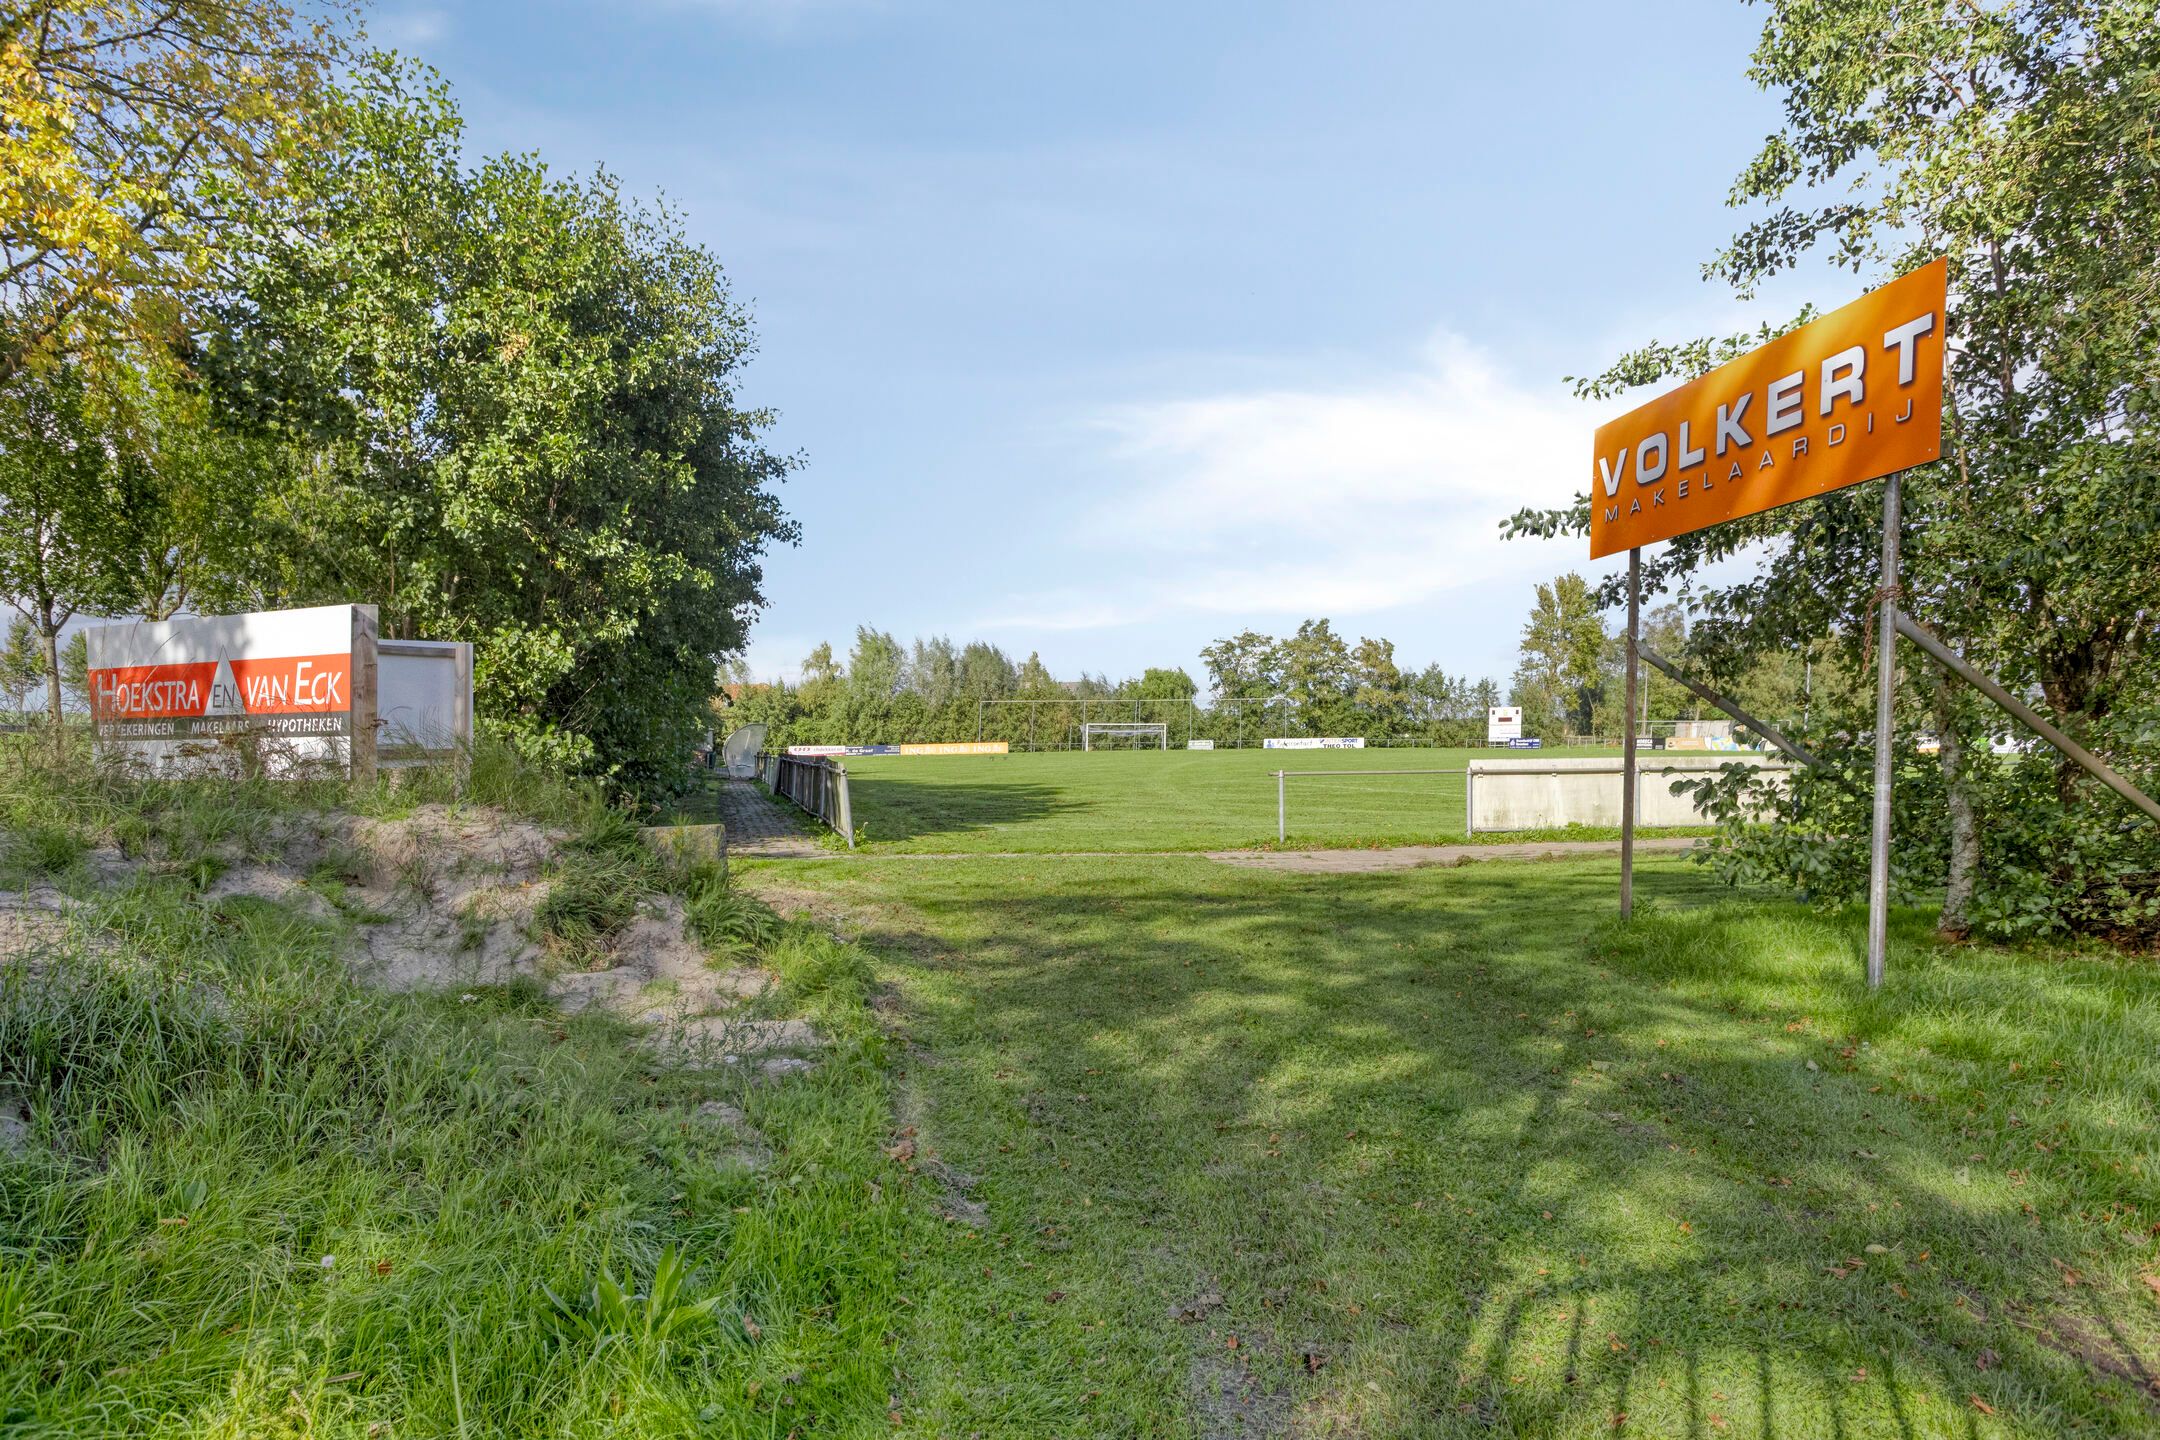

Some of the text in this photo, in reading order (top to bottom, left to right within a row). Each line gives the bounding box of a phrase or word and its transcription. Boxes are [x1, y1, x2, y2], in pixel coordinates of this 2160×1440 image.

[1598, 312, 1934, 497] VOLKERT
[1604, 398, 1912, 523] MAKELAARDIJ
[97, 661, 343, 713] HOEKSTRA EN VAN ECK
[267, 717, 342, 734] HYPOTHEKEN
[905, 747, 923, 755] ING
[939, 746, 958, 754] ING
[973, 745, 992, 753] ING
